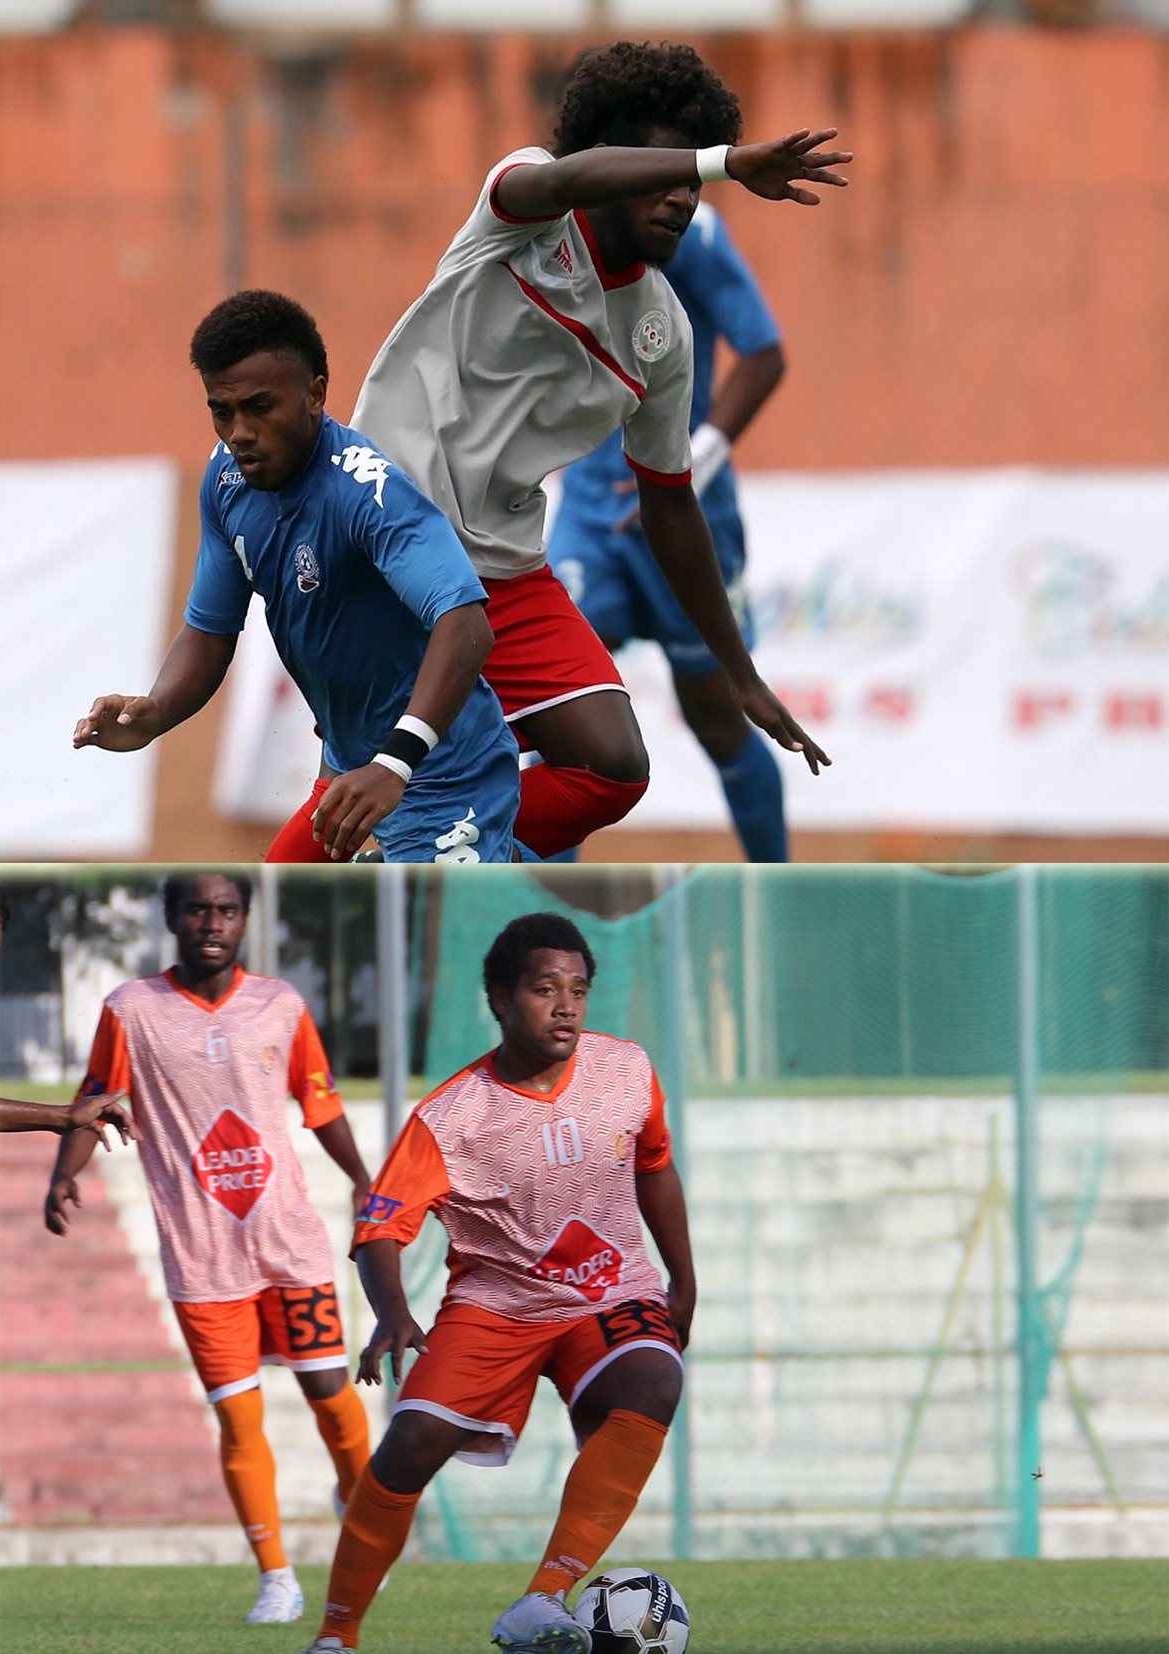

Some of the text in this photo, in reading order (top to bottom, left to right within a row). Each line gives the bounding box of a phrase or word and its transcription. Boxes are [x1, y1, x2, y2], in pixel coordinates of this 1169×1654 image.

[206, 1023, 229, 1063] 6
[536, 1116, 584, 1168] 10
[207, 1168, 264, 1193] PRICE
[535, 1249, 614, 1286] EADER
